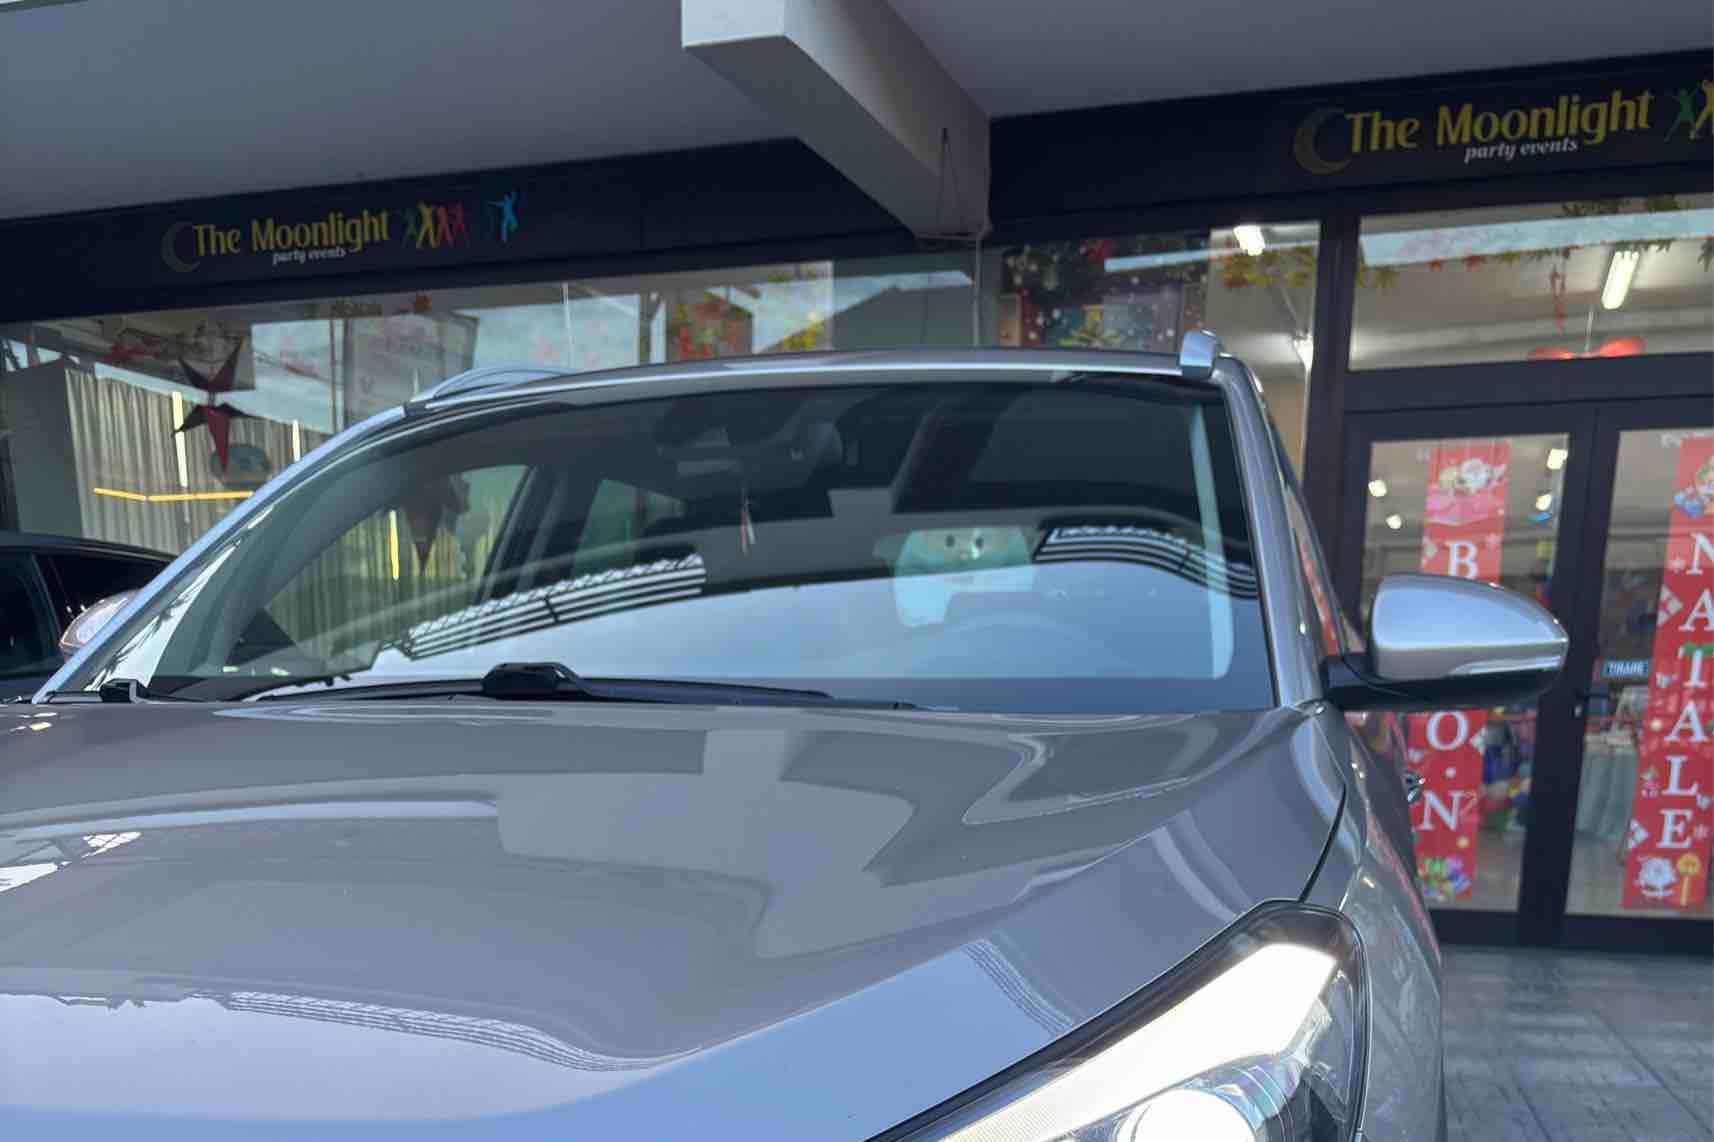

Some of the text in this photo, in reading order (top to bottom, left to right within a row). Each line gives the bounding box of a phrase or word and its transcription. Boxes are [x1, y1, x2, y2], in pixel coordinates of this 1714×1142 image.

[1344, 91, 1653, 153] The Moonlight
[1464, 137, 1578, 164] party events
[192, 209, 389, 257] The Moonlight
[273, 246, 346, 265] party events
[1419, 541, 1479, 831] BON
